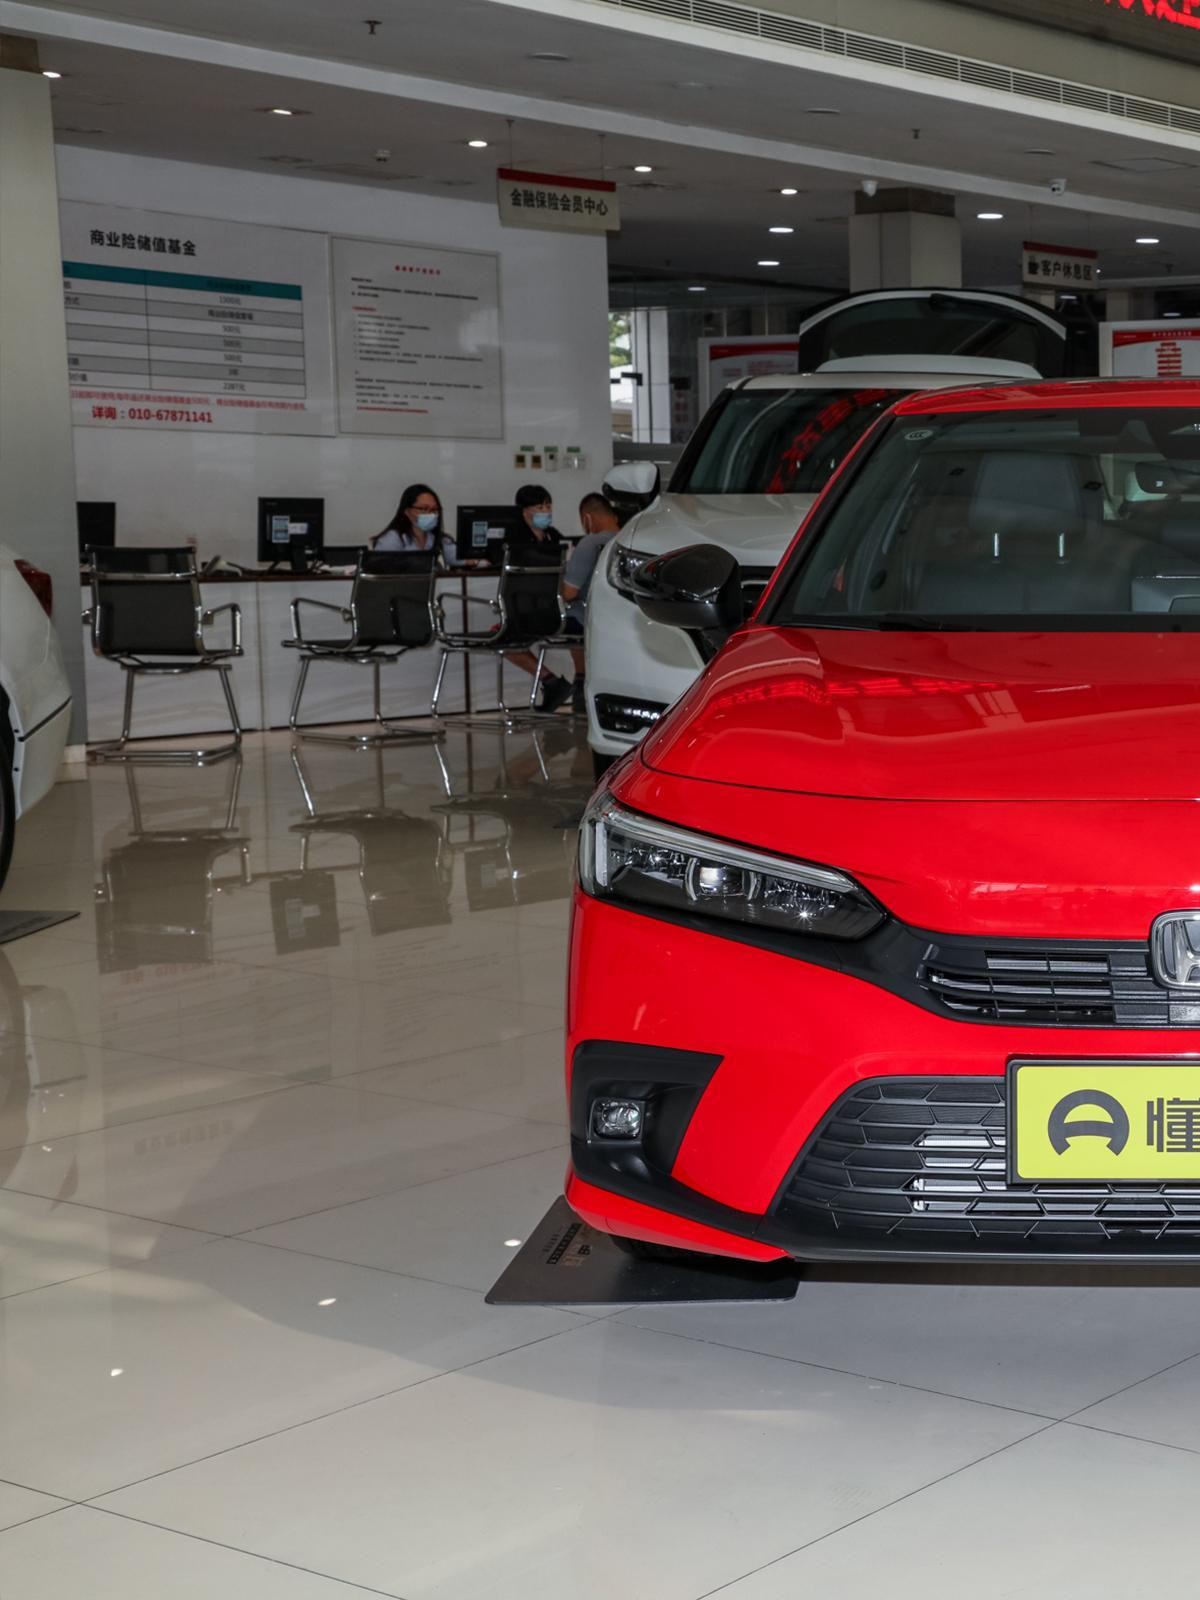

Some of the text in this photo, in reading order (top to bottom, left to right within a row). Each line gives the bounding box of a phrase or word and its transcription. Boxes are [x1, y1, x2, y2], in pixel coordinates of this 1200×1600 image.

[510, 187, 609, 216] 金融保险会员中心
[89, 229, 197, 256] 商业险储值基金
[1041, 259, 1093, 281] 客户休息区
